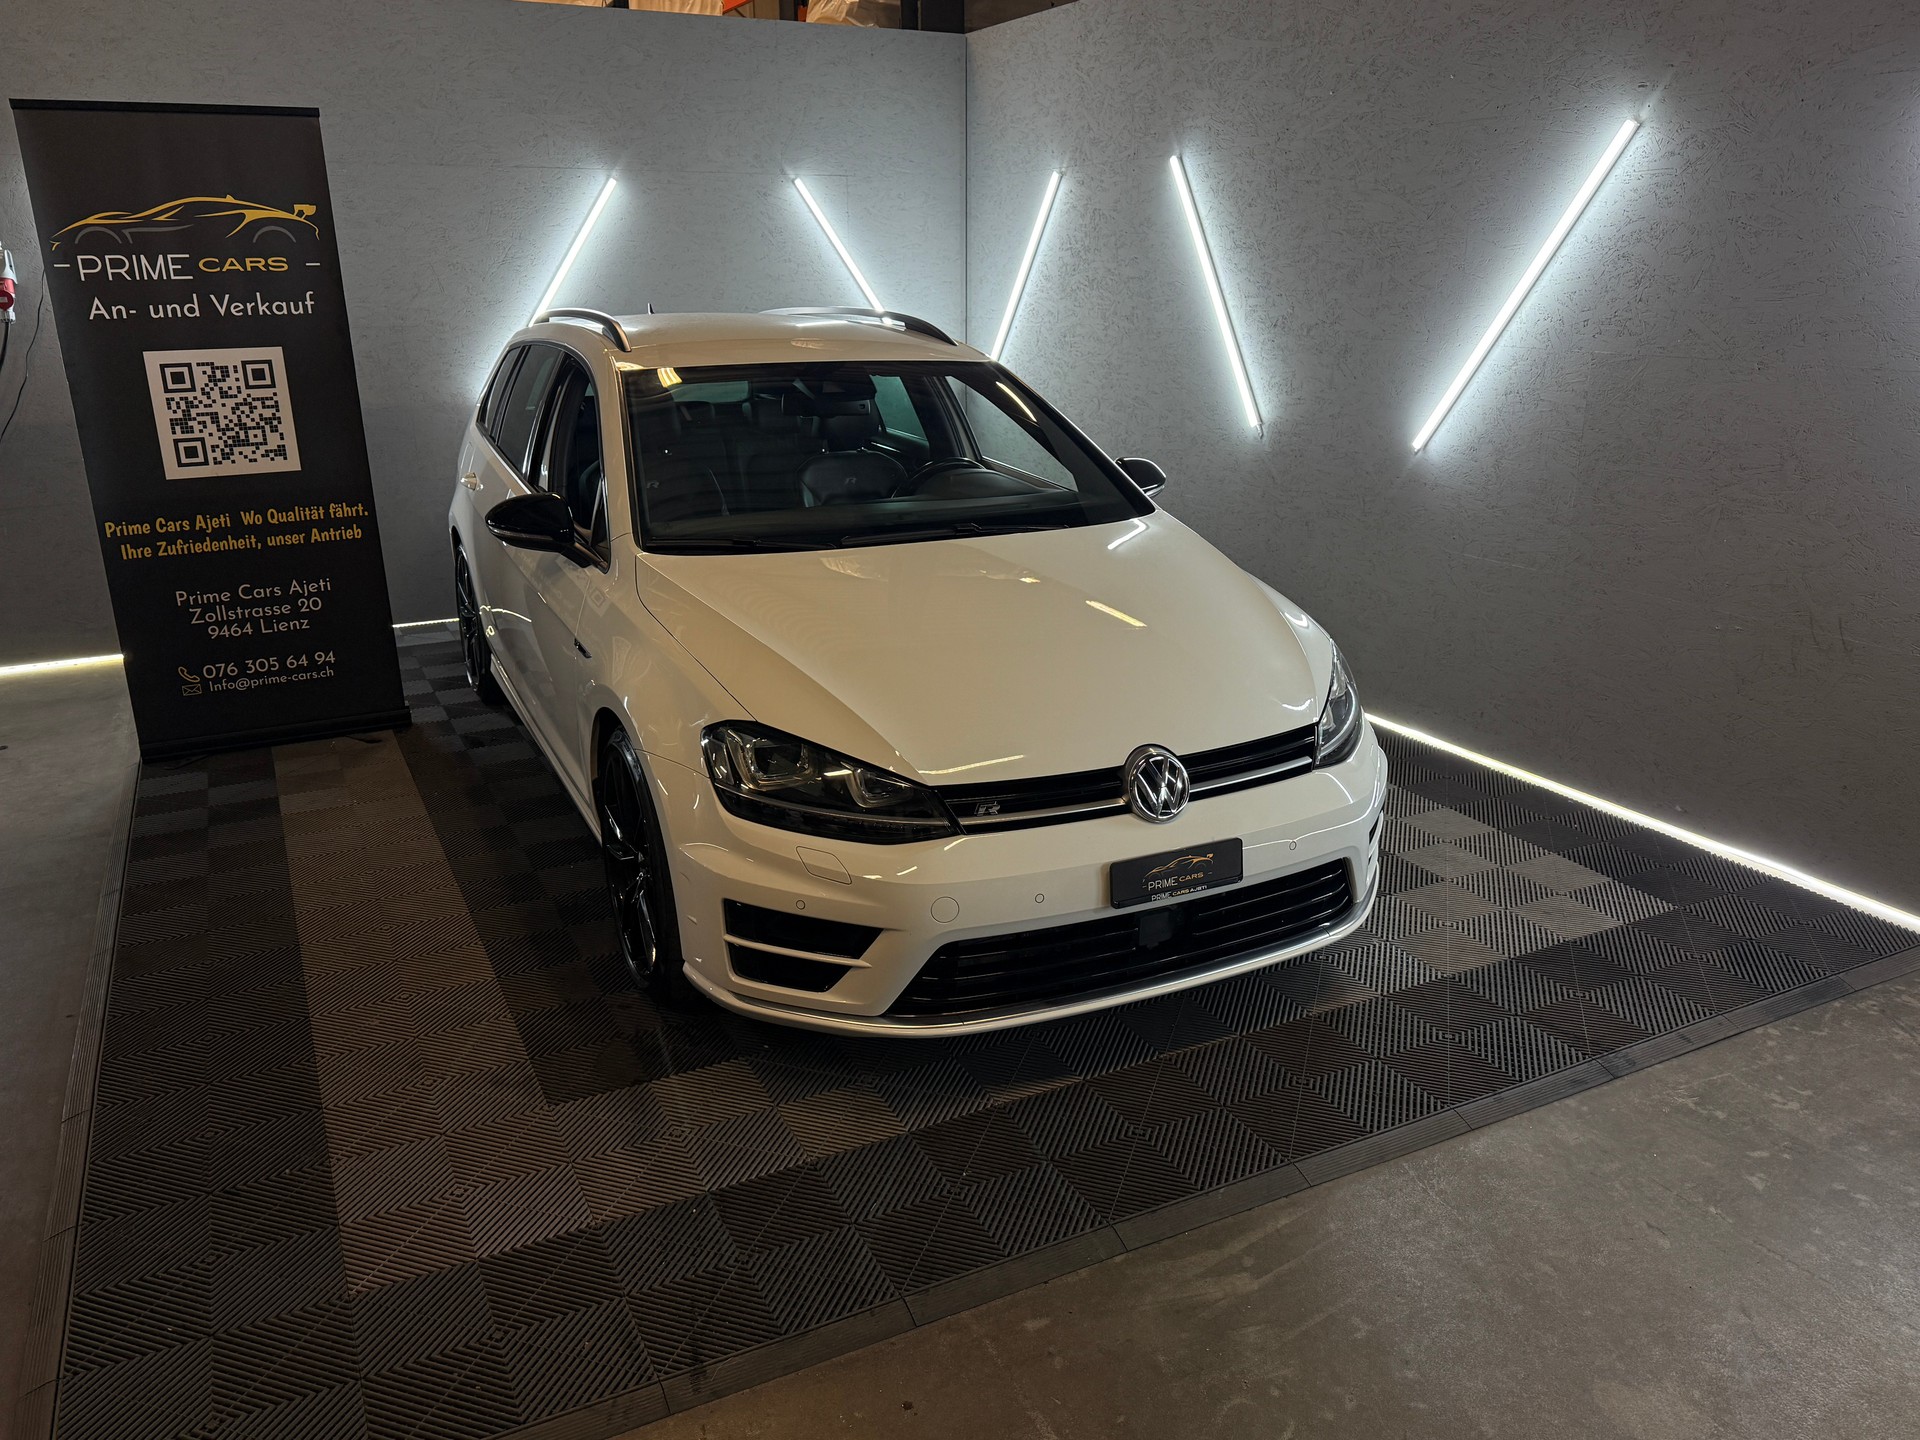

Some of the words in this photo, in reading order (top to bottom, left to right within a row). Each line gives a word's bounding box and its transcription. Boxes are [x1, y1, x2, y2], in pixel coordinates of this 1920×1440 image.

[76, 253, 194, 282] PRIME
[197, 256, 290, 273] CARS
[88, 296, 137, 320] An-
[149, 293, 201, 319] und
[209, 291, 315, 317] Verkauf
[104, 521, 151, 538] Prime
[155, 517, 190, 533] Cars
[195, 513, 231, 533] Ajeti
[240, 511, 263, 526] Wo
[267, 505, 325, 524] Qualität
[329, 502, 369, 519] fährt.
[120, 543, 152, 560] Ihre
[156, 534, 262, 557] Zufriedenheit,
[267, 533, 305, 547] unser
[310, 524, 362, 543] Antrieb
[175, 590, 231, 606] Prime
[238, 584, 282, 600] Cars
[288, 578, 332, 597] Ajeti
[189, 603, 292, 625] Zollstrasse
[297, 597, 323, 613] 20
[207, 623, 254, 639] 9464
[260, 617, 310, 634] Lienz
[202, 662, 238, 679] 076
[245, 657, 280, 674] 305
[286, 653, 309, 669] 64
[314, 650, 336, 665] 94
[208, 666, 335, 692] Info@prime-cars.ch
[1147, 875, 1179, 892] PRIME
[1178, 871, 1205, 883] CARS
[1151, 890, 1173, 902] PRIME
[1172, 887, 1190, 897] CARS
